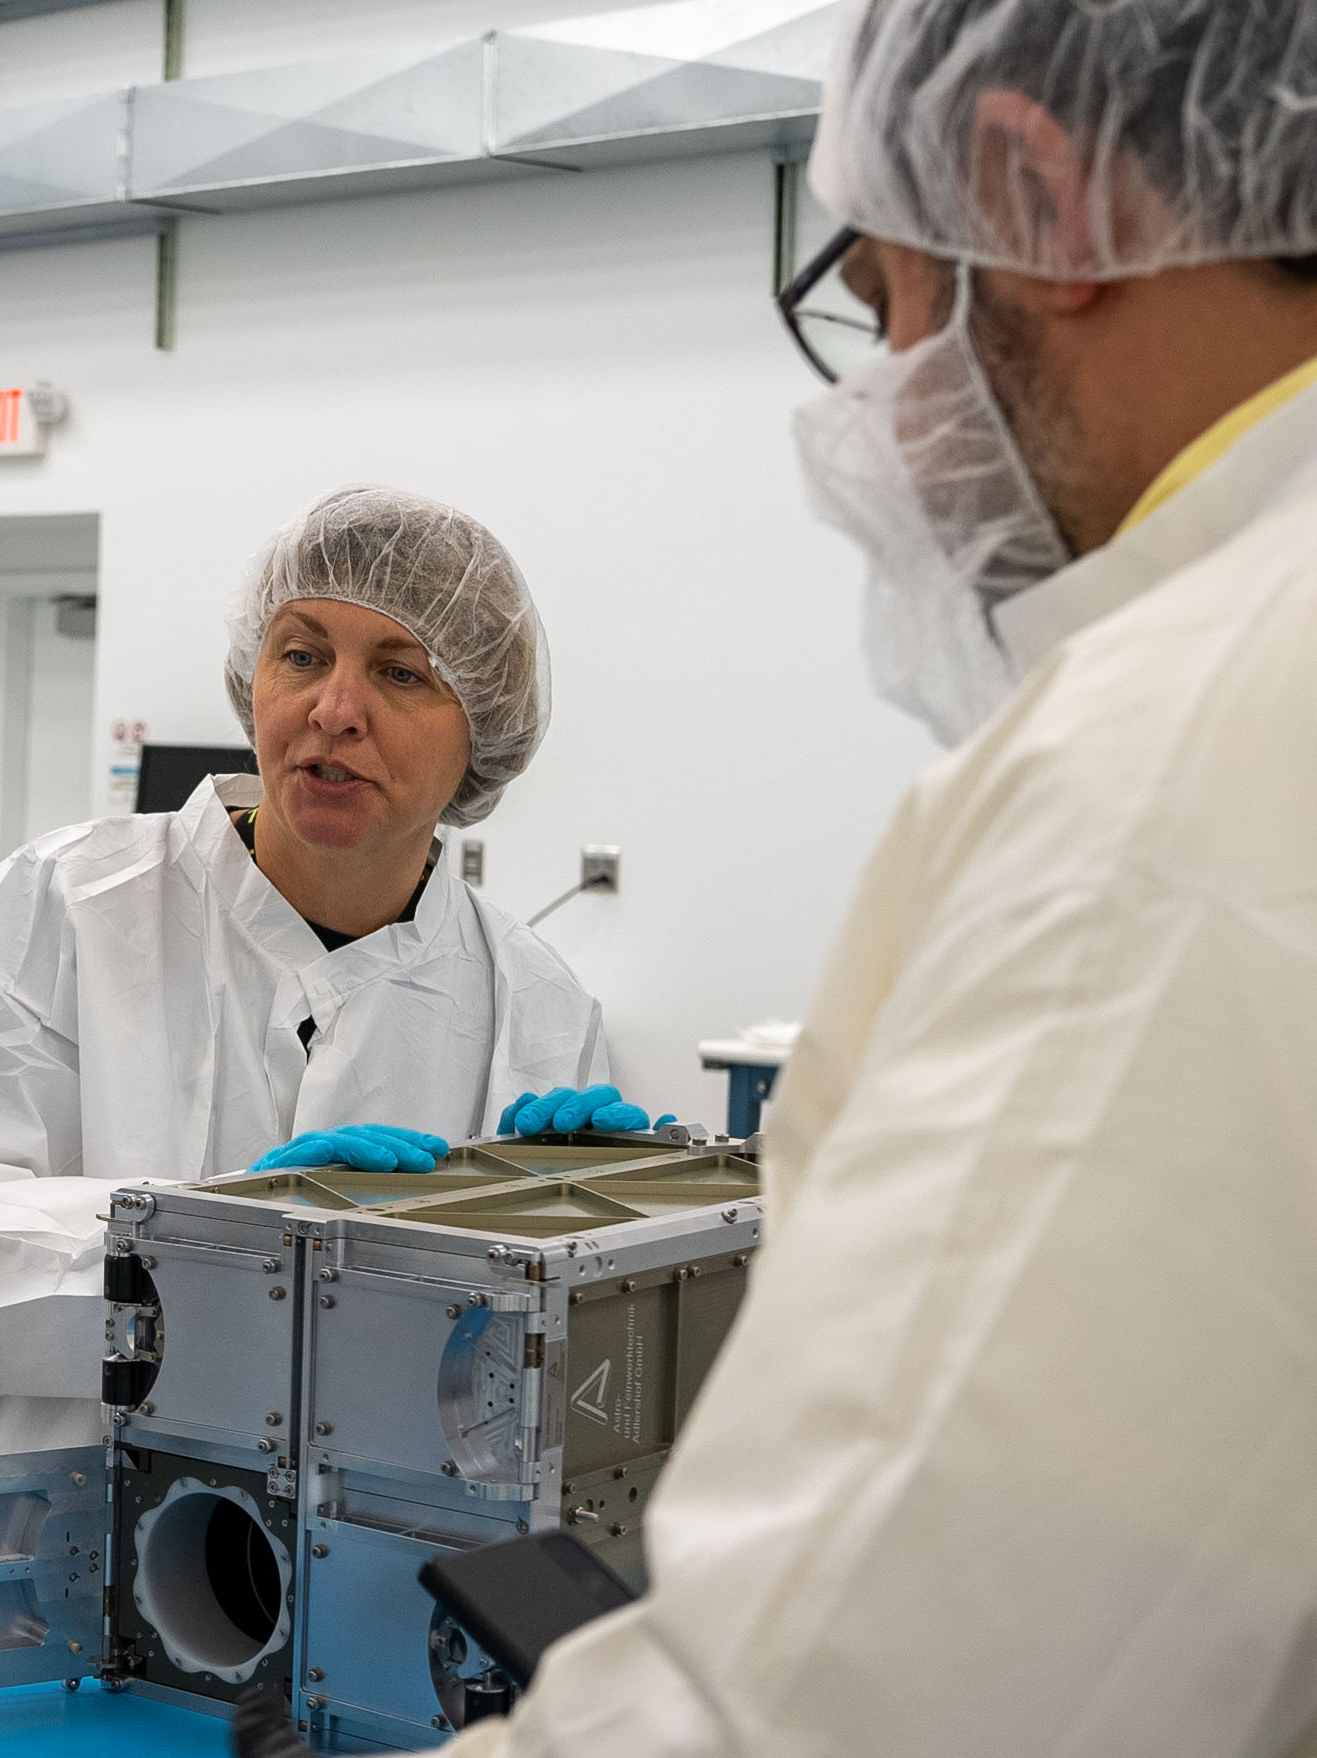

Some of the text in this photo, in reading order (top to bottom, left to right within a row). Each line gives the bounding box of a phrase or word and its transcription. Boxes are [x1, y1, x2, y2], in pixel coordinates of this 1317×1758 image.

[623, 1303, 637, 1439] und Feinwerktechnik
[632, 1334, 644, 1444] Adlershof GmbH
